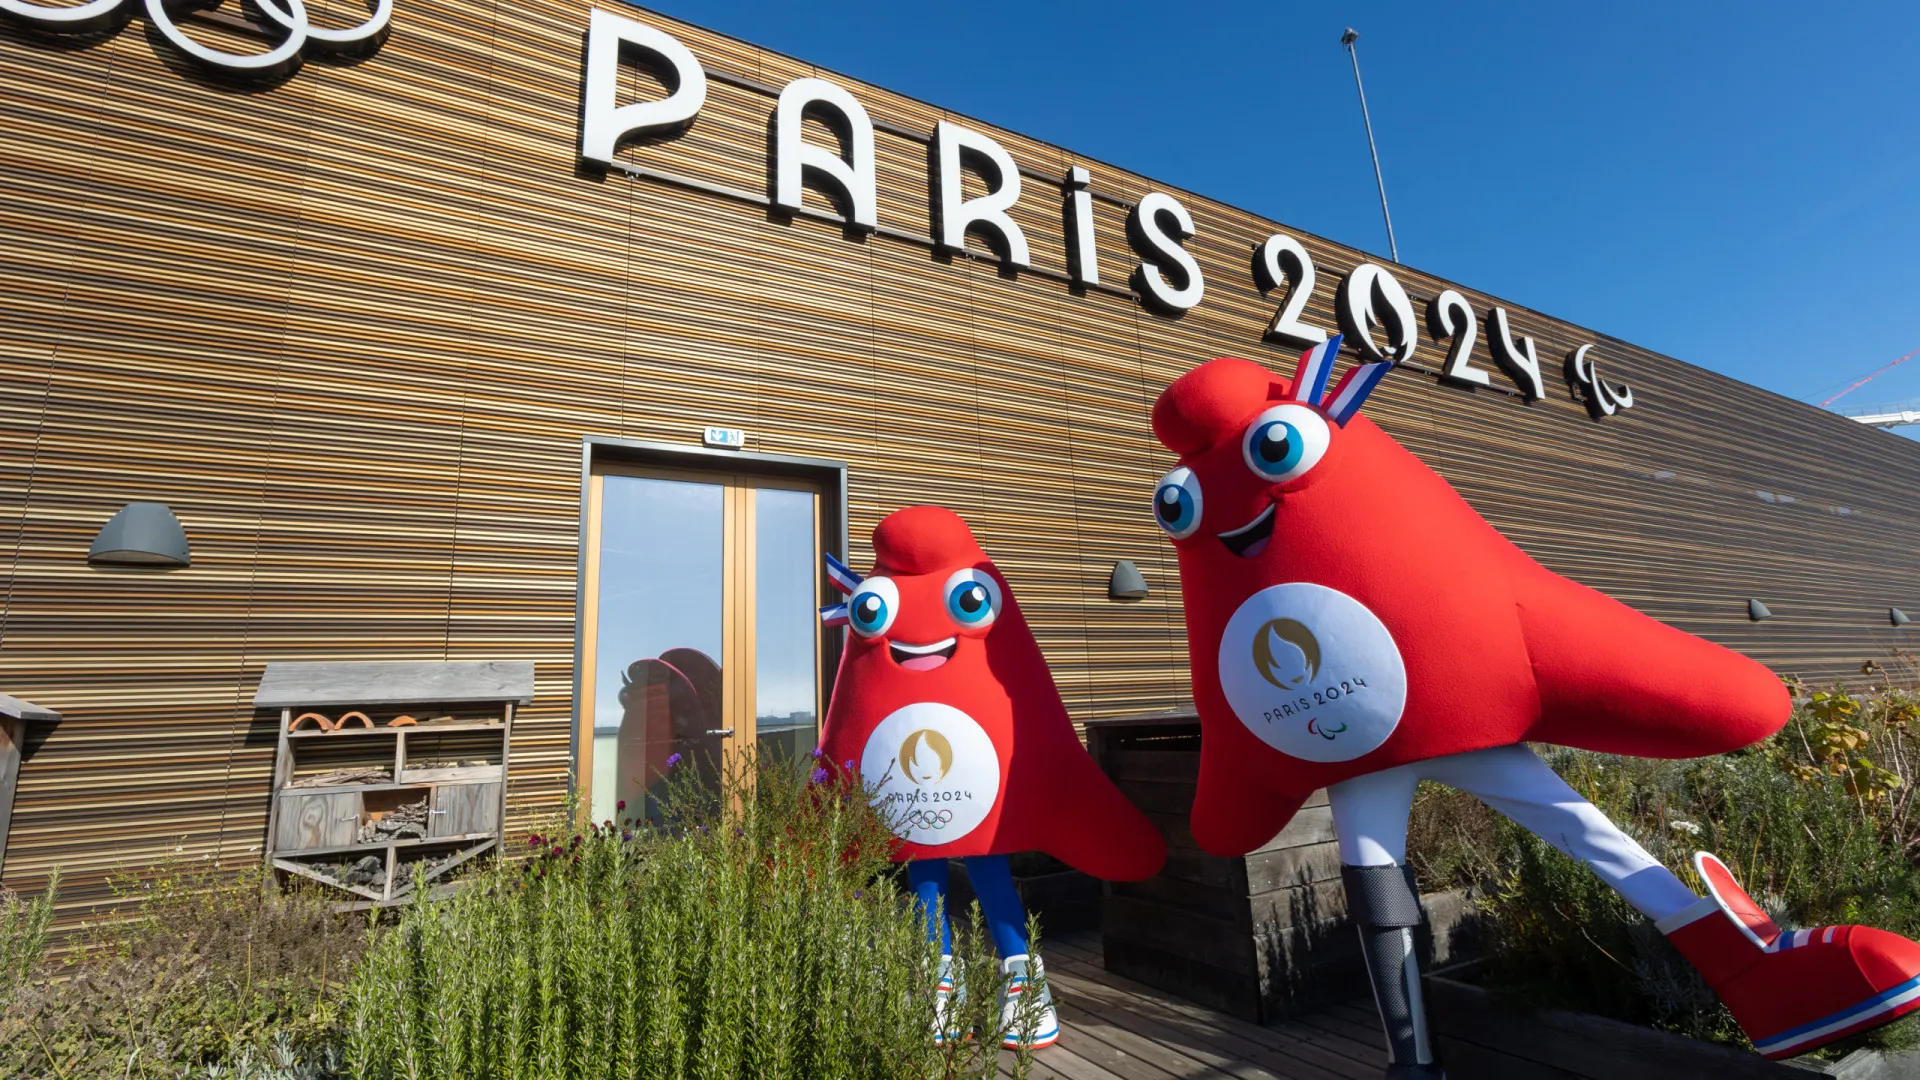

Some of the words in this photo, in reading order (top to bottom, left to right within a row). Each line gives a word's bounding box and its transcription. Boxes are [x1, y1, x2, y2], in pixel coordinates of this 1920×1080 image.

[1264, 233, 1546, 400] 2024
[1313, 678, 1367, 705] 2024
[932, 790, 972, 803] 2024
